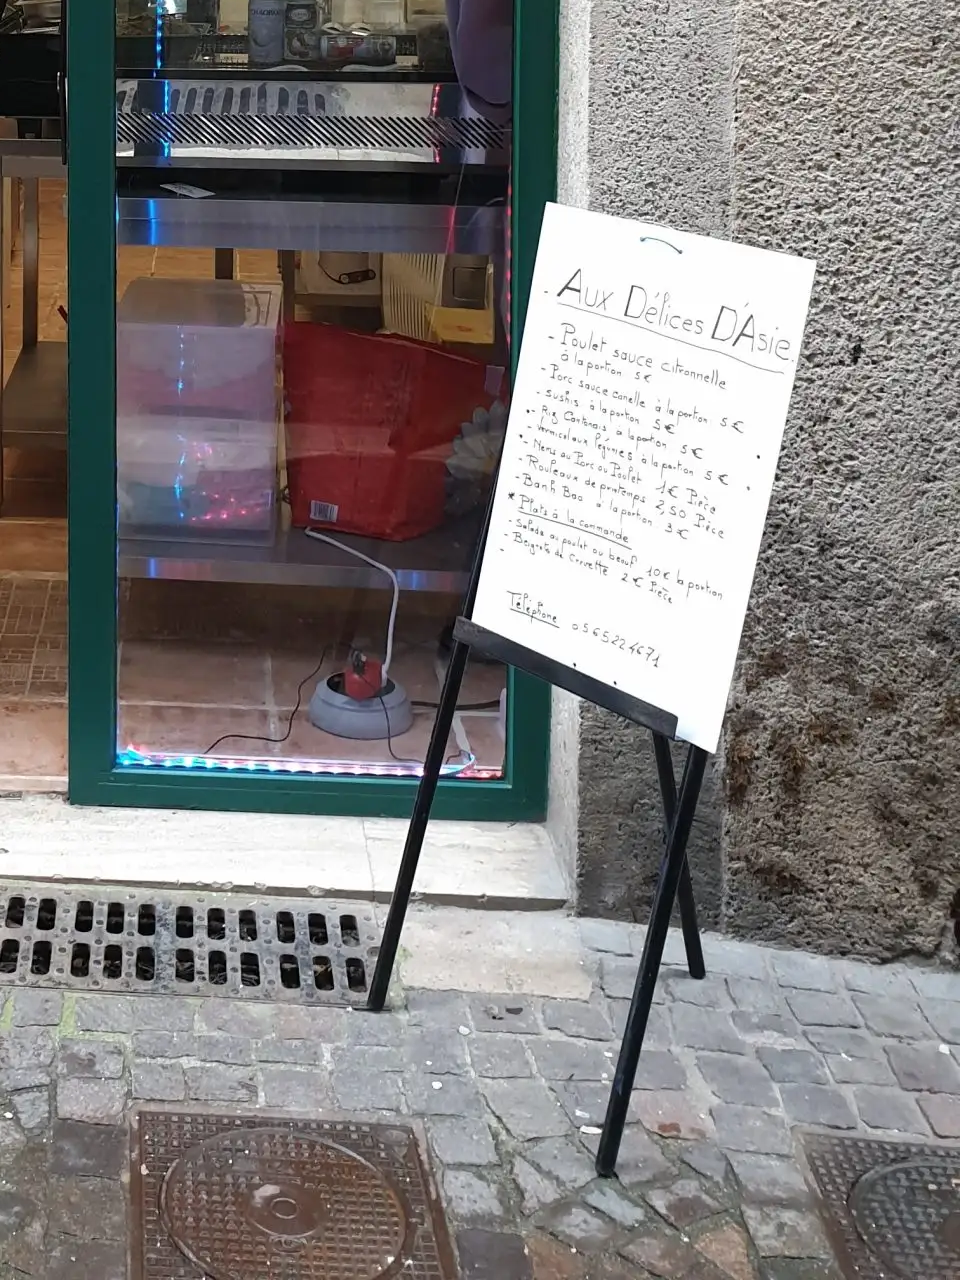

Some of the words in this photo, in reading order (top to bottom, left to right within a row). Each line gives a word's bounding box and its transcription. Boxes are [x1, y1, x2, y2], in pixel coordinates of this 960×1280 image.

[556, 267, 613, 310] Aux
[623, 284, 703, 334] Délices
[560, 322, 607, 352] Poulet
[612, 349, 652, 368] sauce
[660, 357, 725, 389] citronnelle
[586, 360, 621, 376] portion
[549, 363, 572, 384] Porc
[578, 379, 608, 396] sauce
[676, 405, 707, 425] portion
[609, 407, 639, 424] portion
[635, 434, 666, 450] portion
[525, 454, 578, 481] Rouleaux
[572, 450, 593, 469] Porc
[609, 461, 641, 484] Poulet
[660, 460, 693, 478] portion
[522, 472, 555, 493] Banh
[620, 508, 652, 525] portion
[518, 493, 547, 516] Plats
[576, 519, 628, 543] commande
[686, 581, 722, 600] portion
